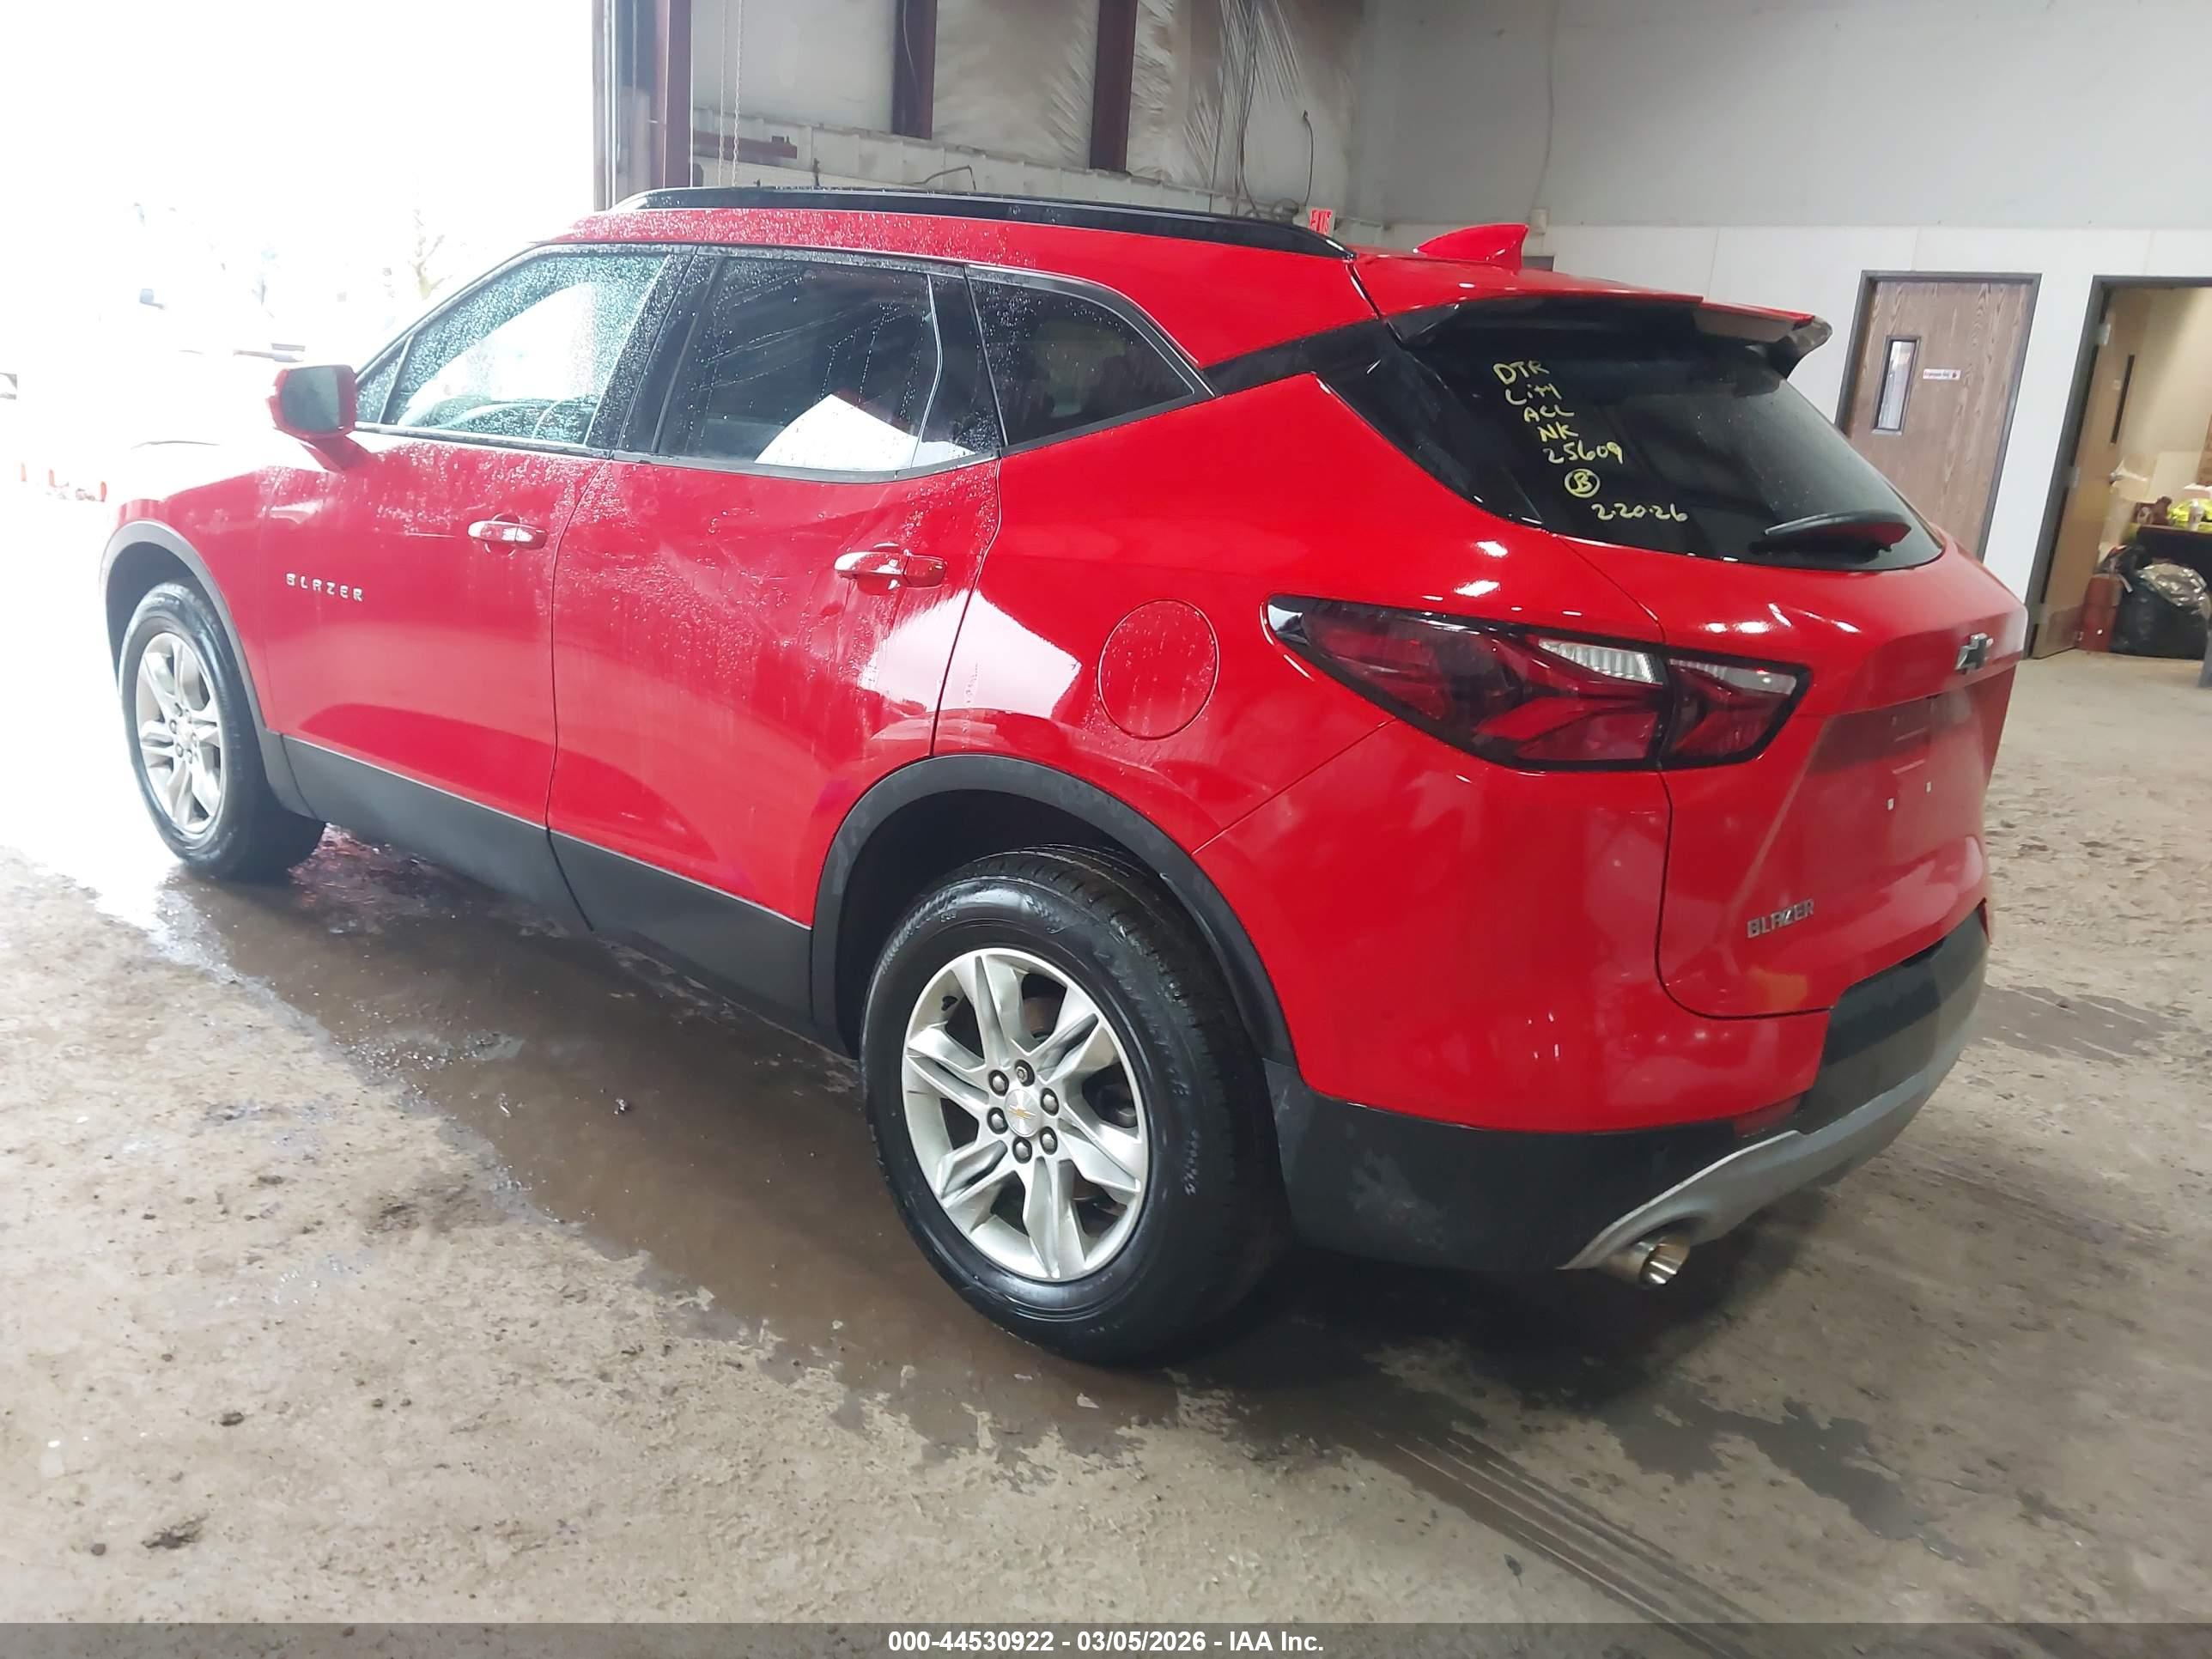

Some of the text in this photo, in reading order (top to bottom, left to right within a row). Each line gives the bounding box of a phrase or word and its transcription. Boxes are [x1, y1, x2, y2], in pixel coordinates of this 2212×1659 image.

[1492, 361, 1549, 384] DTR
[1537, 422, 1579, 443] NK
[1543, 440, 1624, 465] 25609
[286, 573, 363, 602] BLAZER
[1747, 899, 1814, 939] BLAZER
